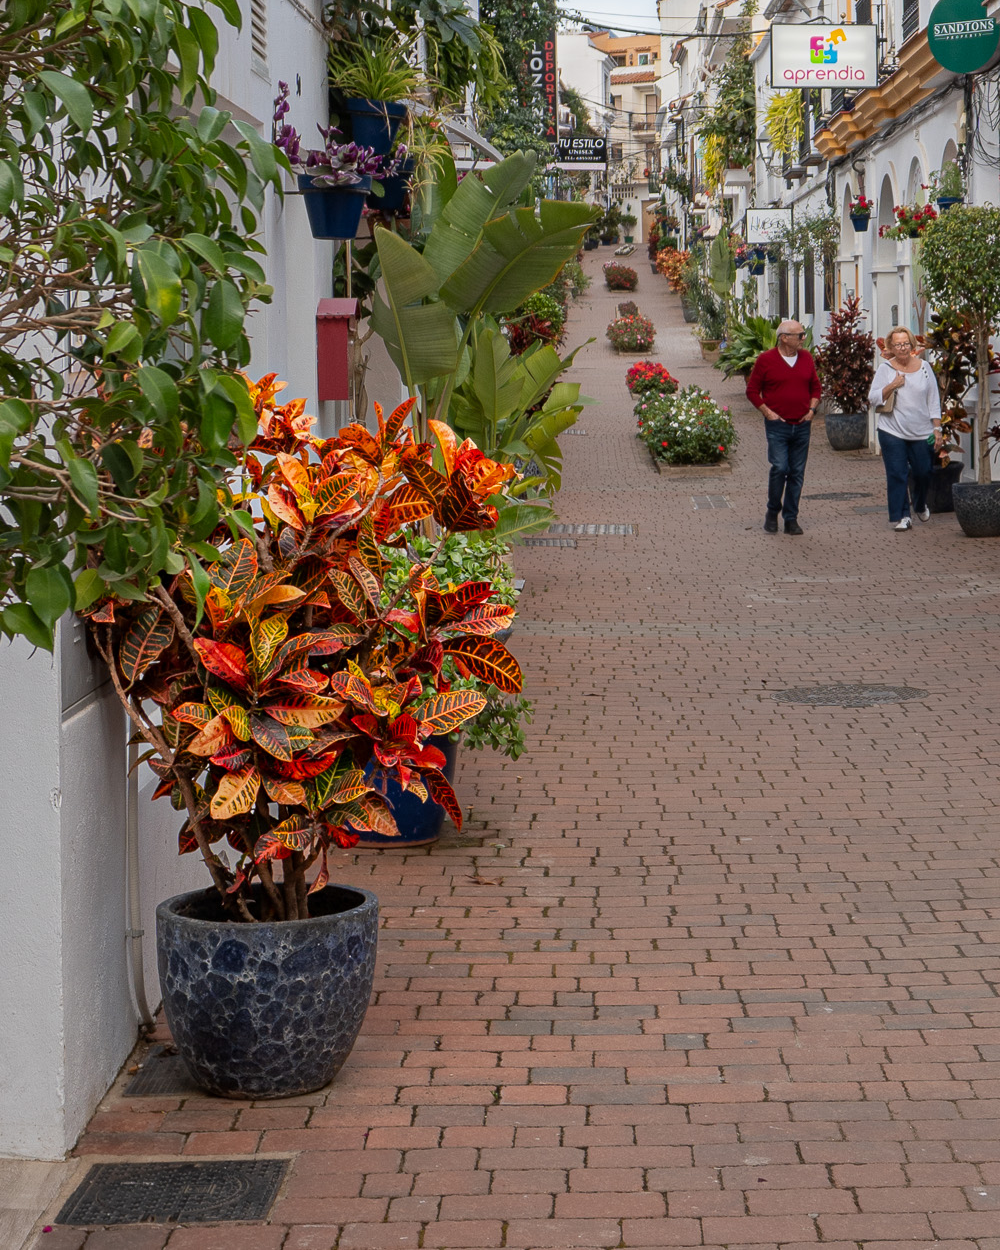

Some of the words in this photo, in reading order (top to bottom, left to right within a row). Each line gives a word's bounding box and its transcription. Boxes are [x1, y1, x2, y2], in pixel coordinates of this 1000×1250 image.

[934, 20, 994, 35] SANDTONS
[783, 65, 865, 84] aprendia
[544, 41, 556, 136] DEPORTIA
[560, 139, 570, 148] TU
[572, 139, 604, 148] ESTILO
